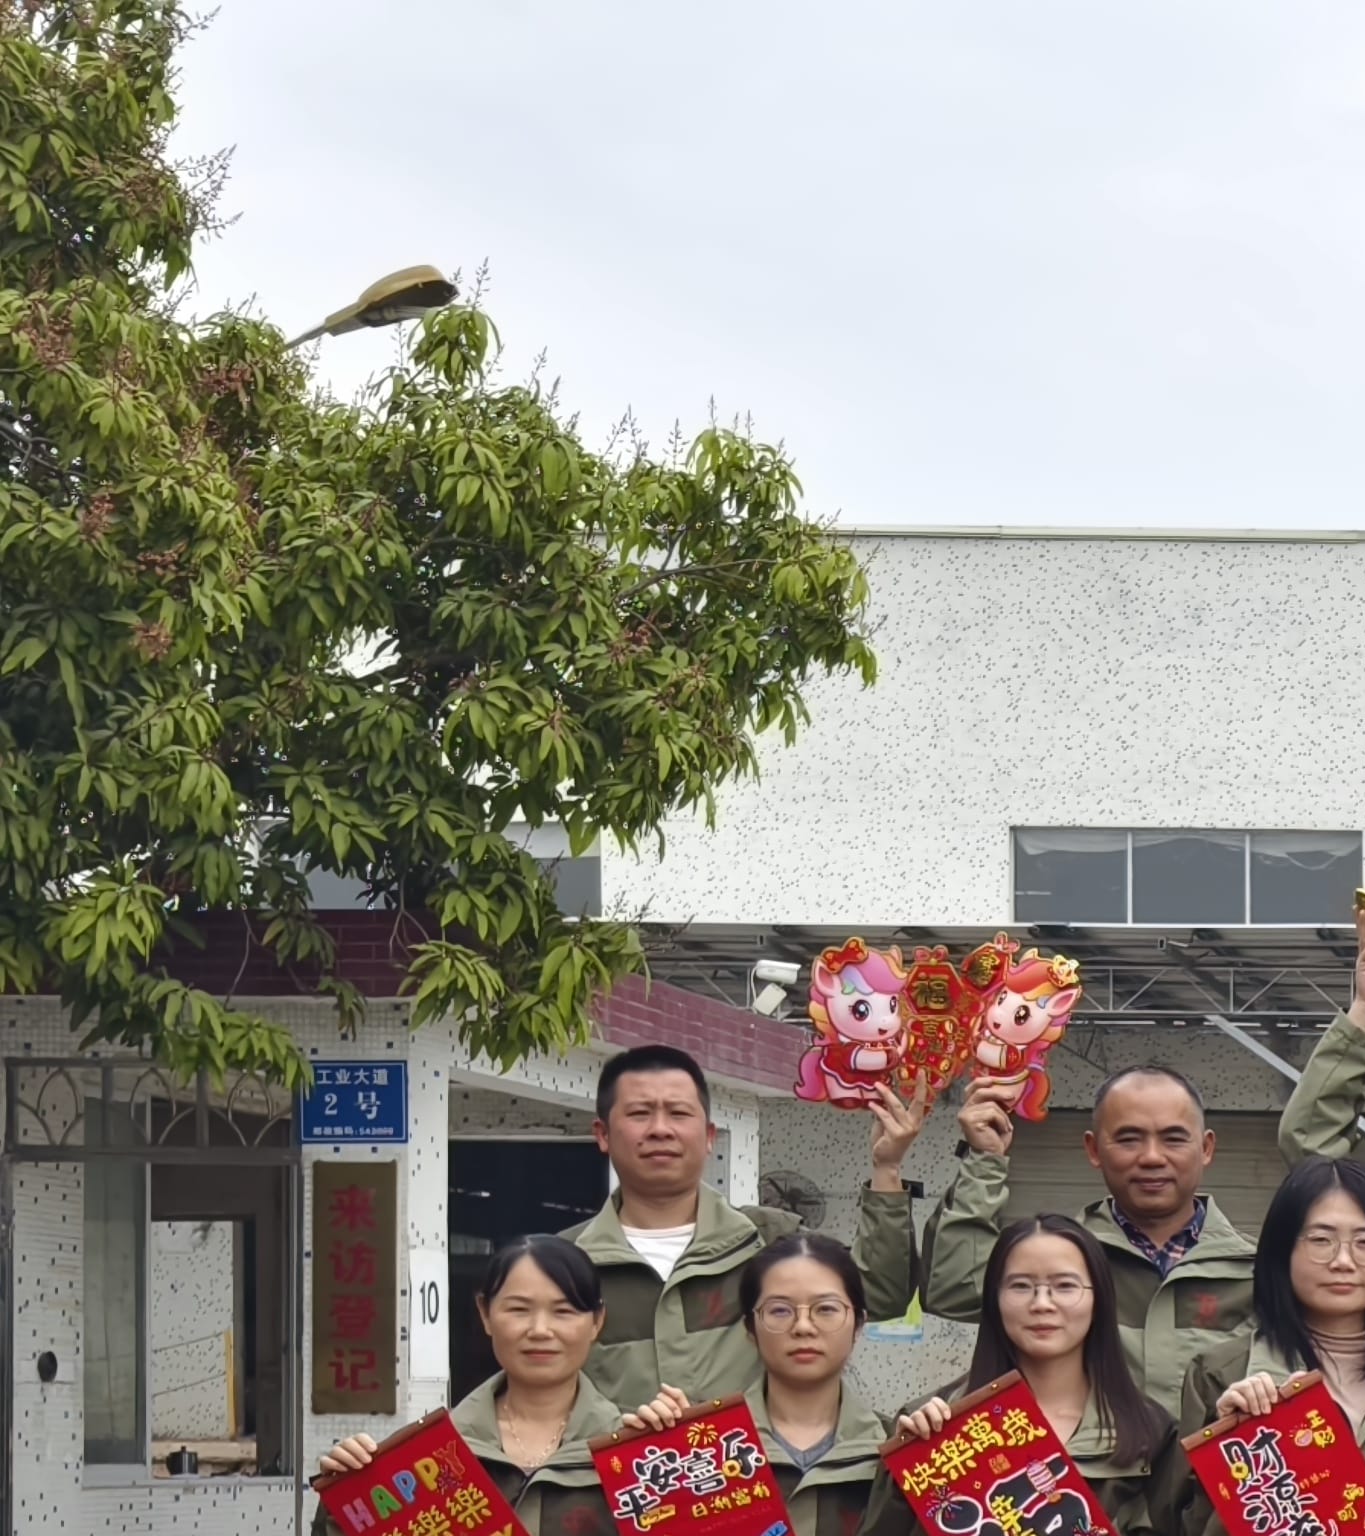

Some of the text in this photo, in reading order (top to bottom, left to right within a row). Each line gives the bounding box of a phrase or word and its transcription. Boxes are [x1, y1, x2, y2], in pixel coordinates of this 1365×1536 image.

[316, 1068, 389, 1085] 工业大道
[324, 1090, 381, 1120] 2 号
[328, 1184, 380, 1392] 来访登记
[419, 1280, 440, 1325] 10
[343, 1440, 466, 1533] HAPPY
[613, 1428, 766, 1531] 平安喜乐
[902, 1408, 1048, 1497] 快樂萬歲
